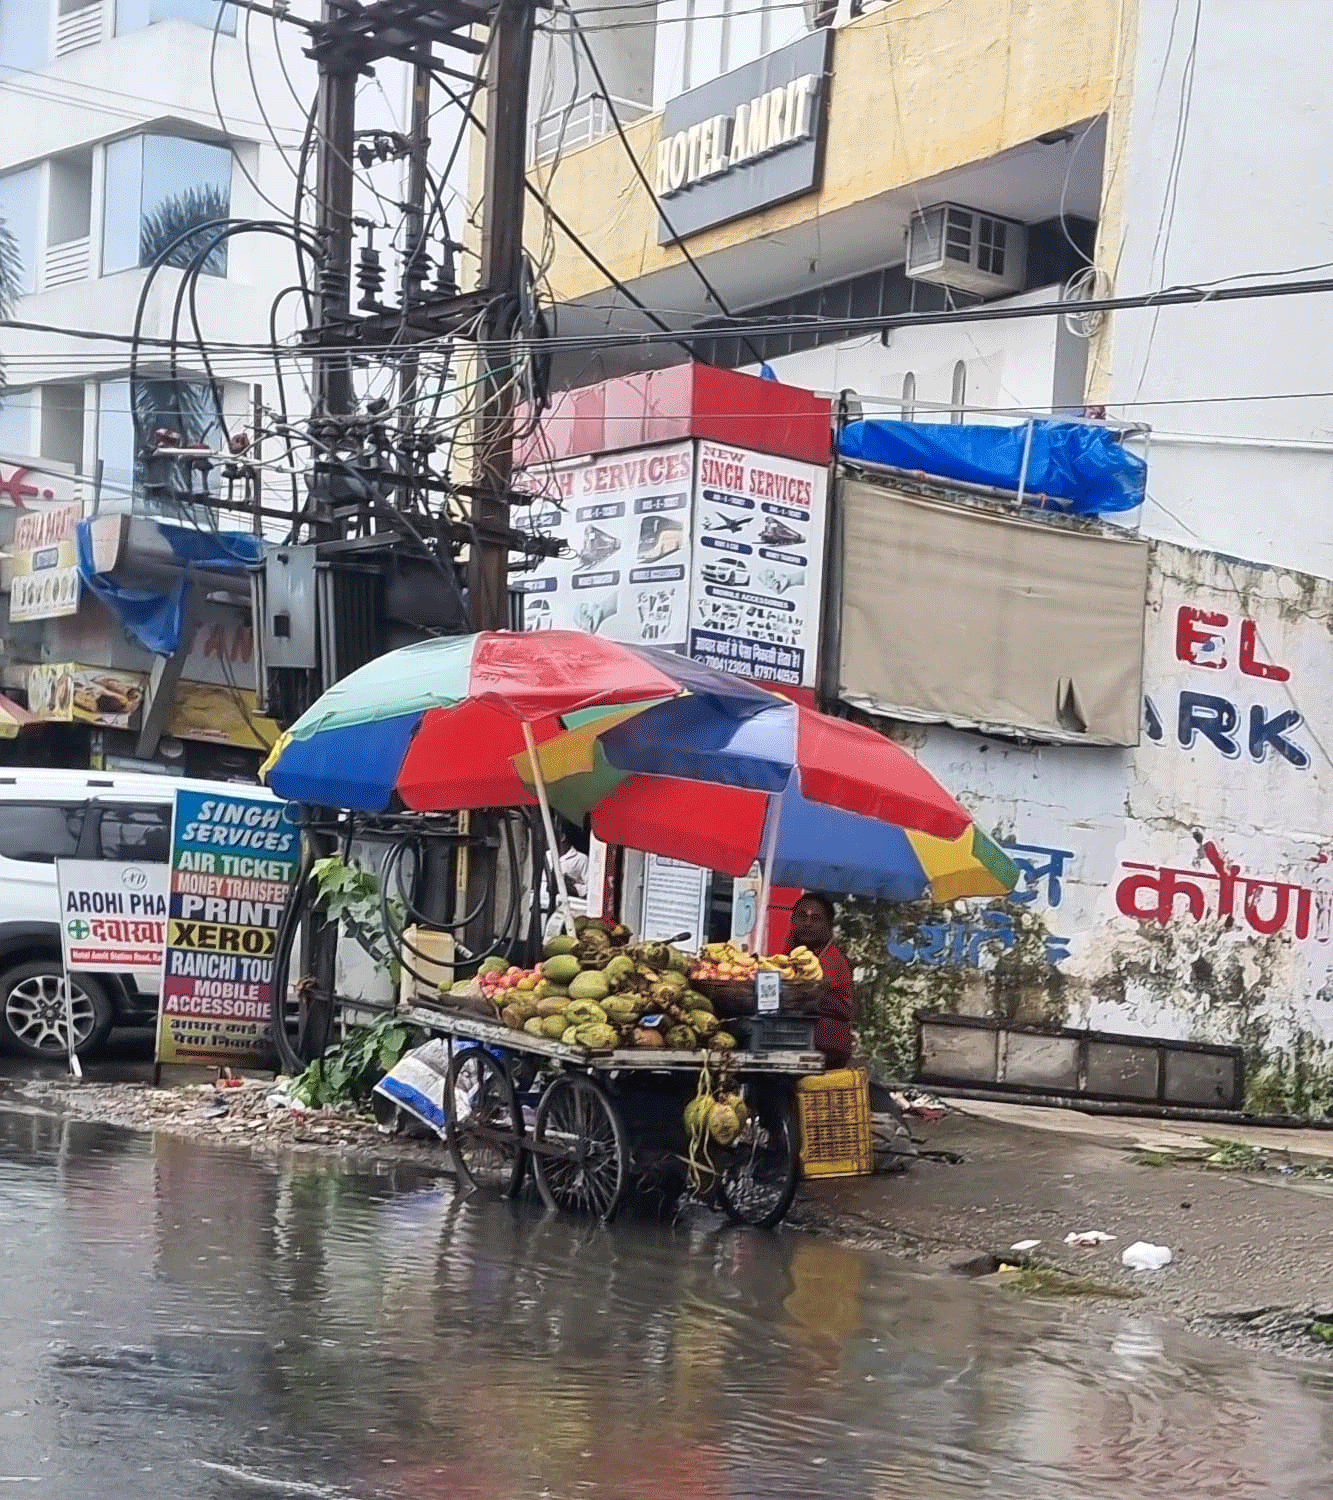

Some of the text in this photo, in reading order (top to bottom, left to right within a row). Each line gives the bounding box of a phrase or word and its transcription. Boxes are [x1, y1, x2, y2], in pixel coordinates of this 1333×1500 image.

[656, 74, 818, 197] HOTEL AMRIT
[703, 445, 746, 462] NEW
[583, 453, 692, 496] SERVICES
[701, 458, 812, 506] SINGH SERVICES
[197, 800, 281, 829] SINGH
[182, 822, 294, 852] SERVICES
[178, 851, 293, 881] AIR TICKET
[178, 872, 225, 896] MONEY
[66, 890, 167, 916] AROHI PHA
[181, 893, 285, 928] PRINT
[90, 918, 166, 944] दवाखा
[170, 950, 273, 983] RANCHI TOU
[194, 979, 260, 1000] MOBILE
[165, 994, 272, 1018] ACCESSORIE
